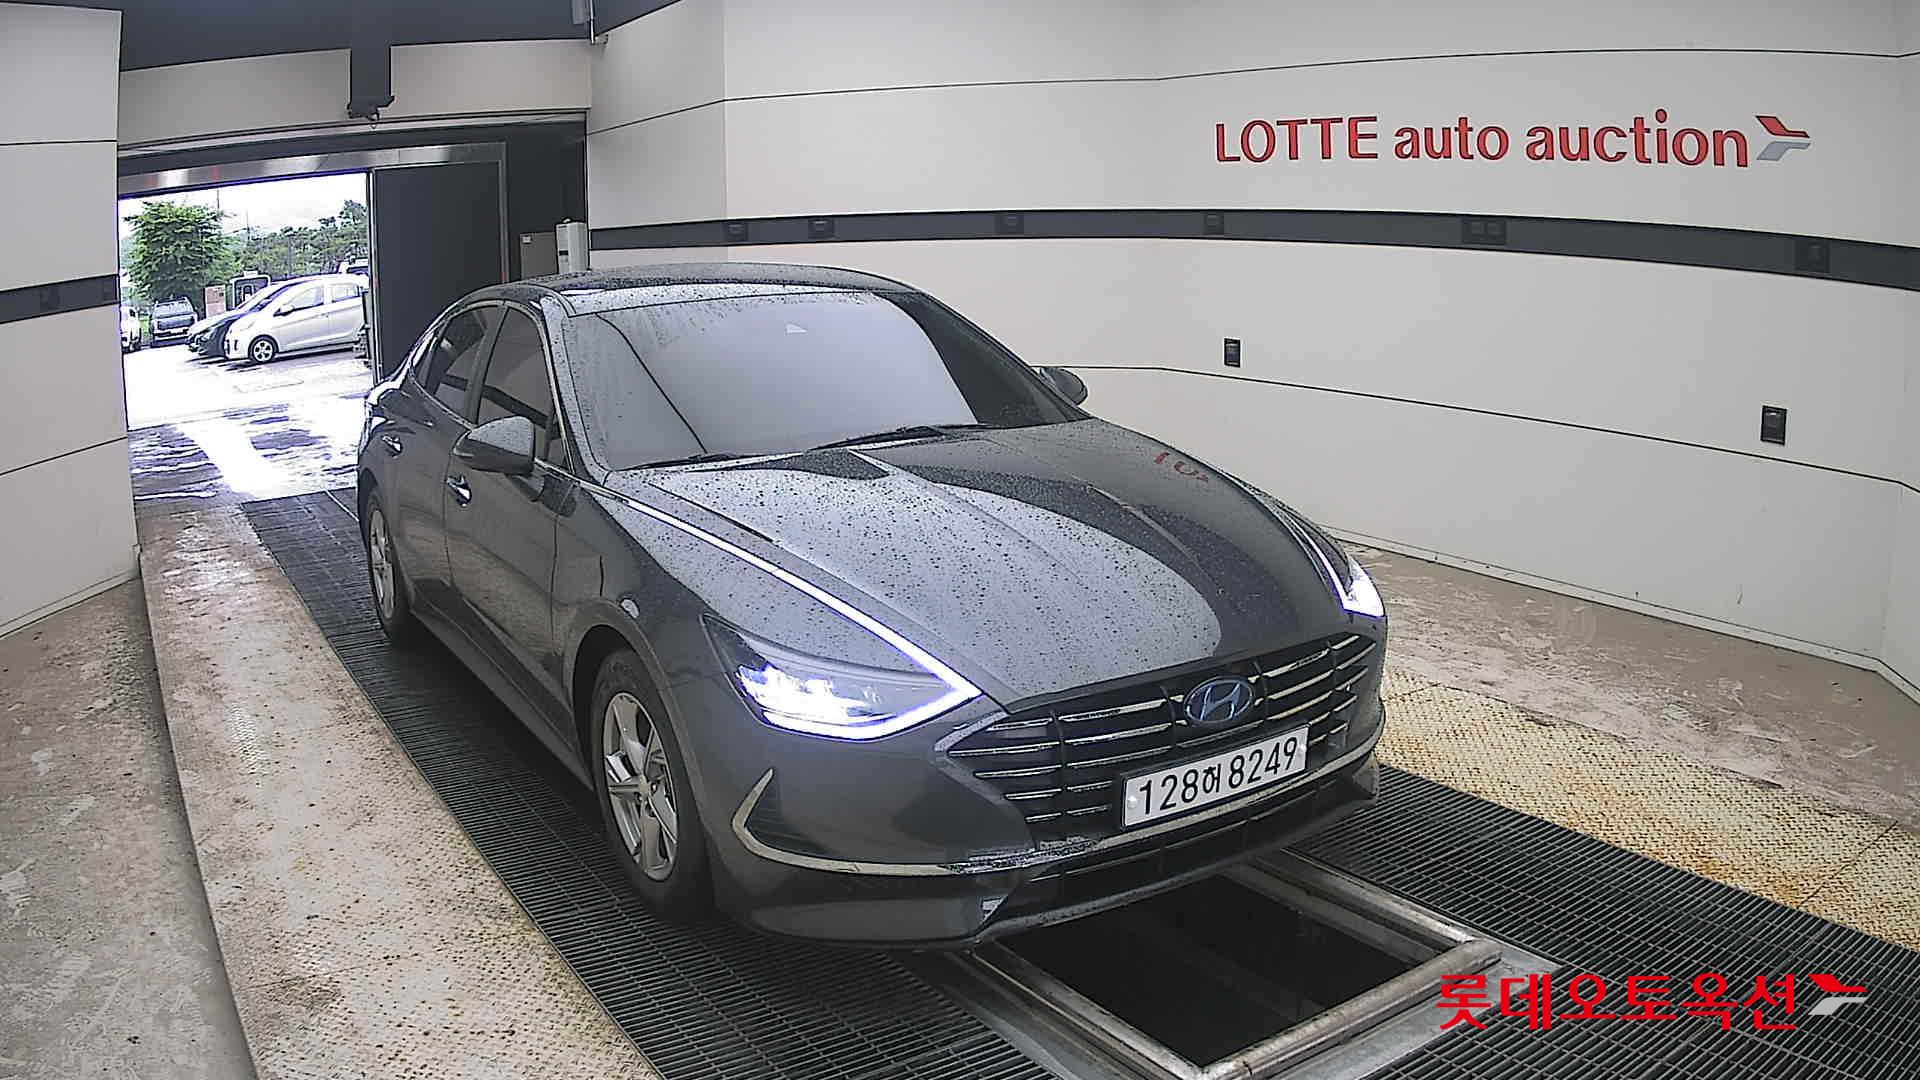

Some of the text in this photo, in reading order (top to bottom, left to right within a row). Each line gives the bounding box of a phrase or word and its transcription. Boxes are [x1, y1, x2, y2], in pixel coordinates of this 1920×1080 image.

[1215, 108, 1749, 168] LOTTE auto auction
[1228, 736, 1298, 789] 8249
